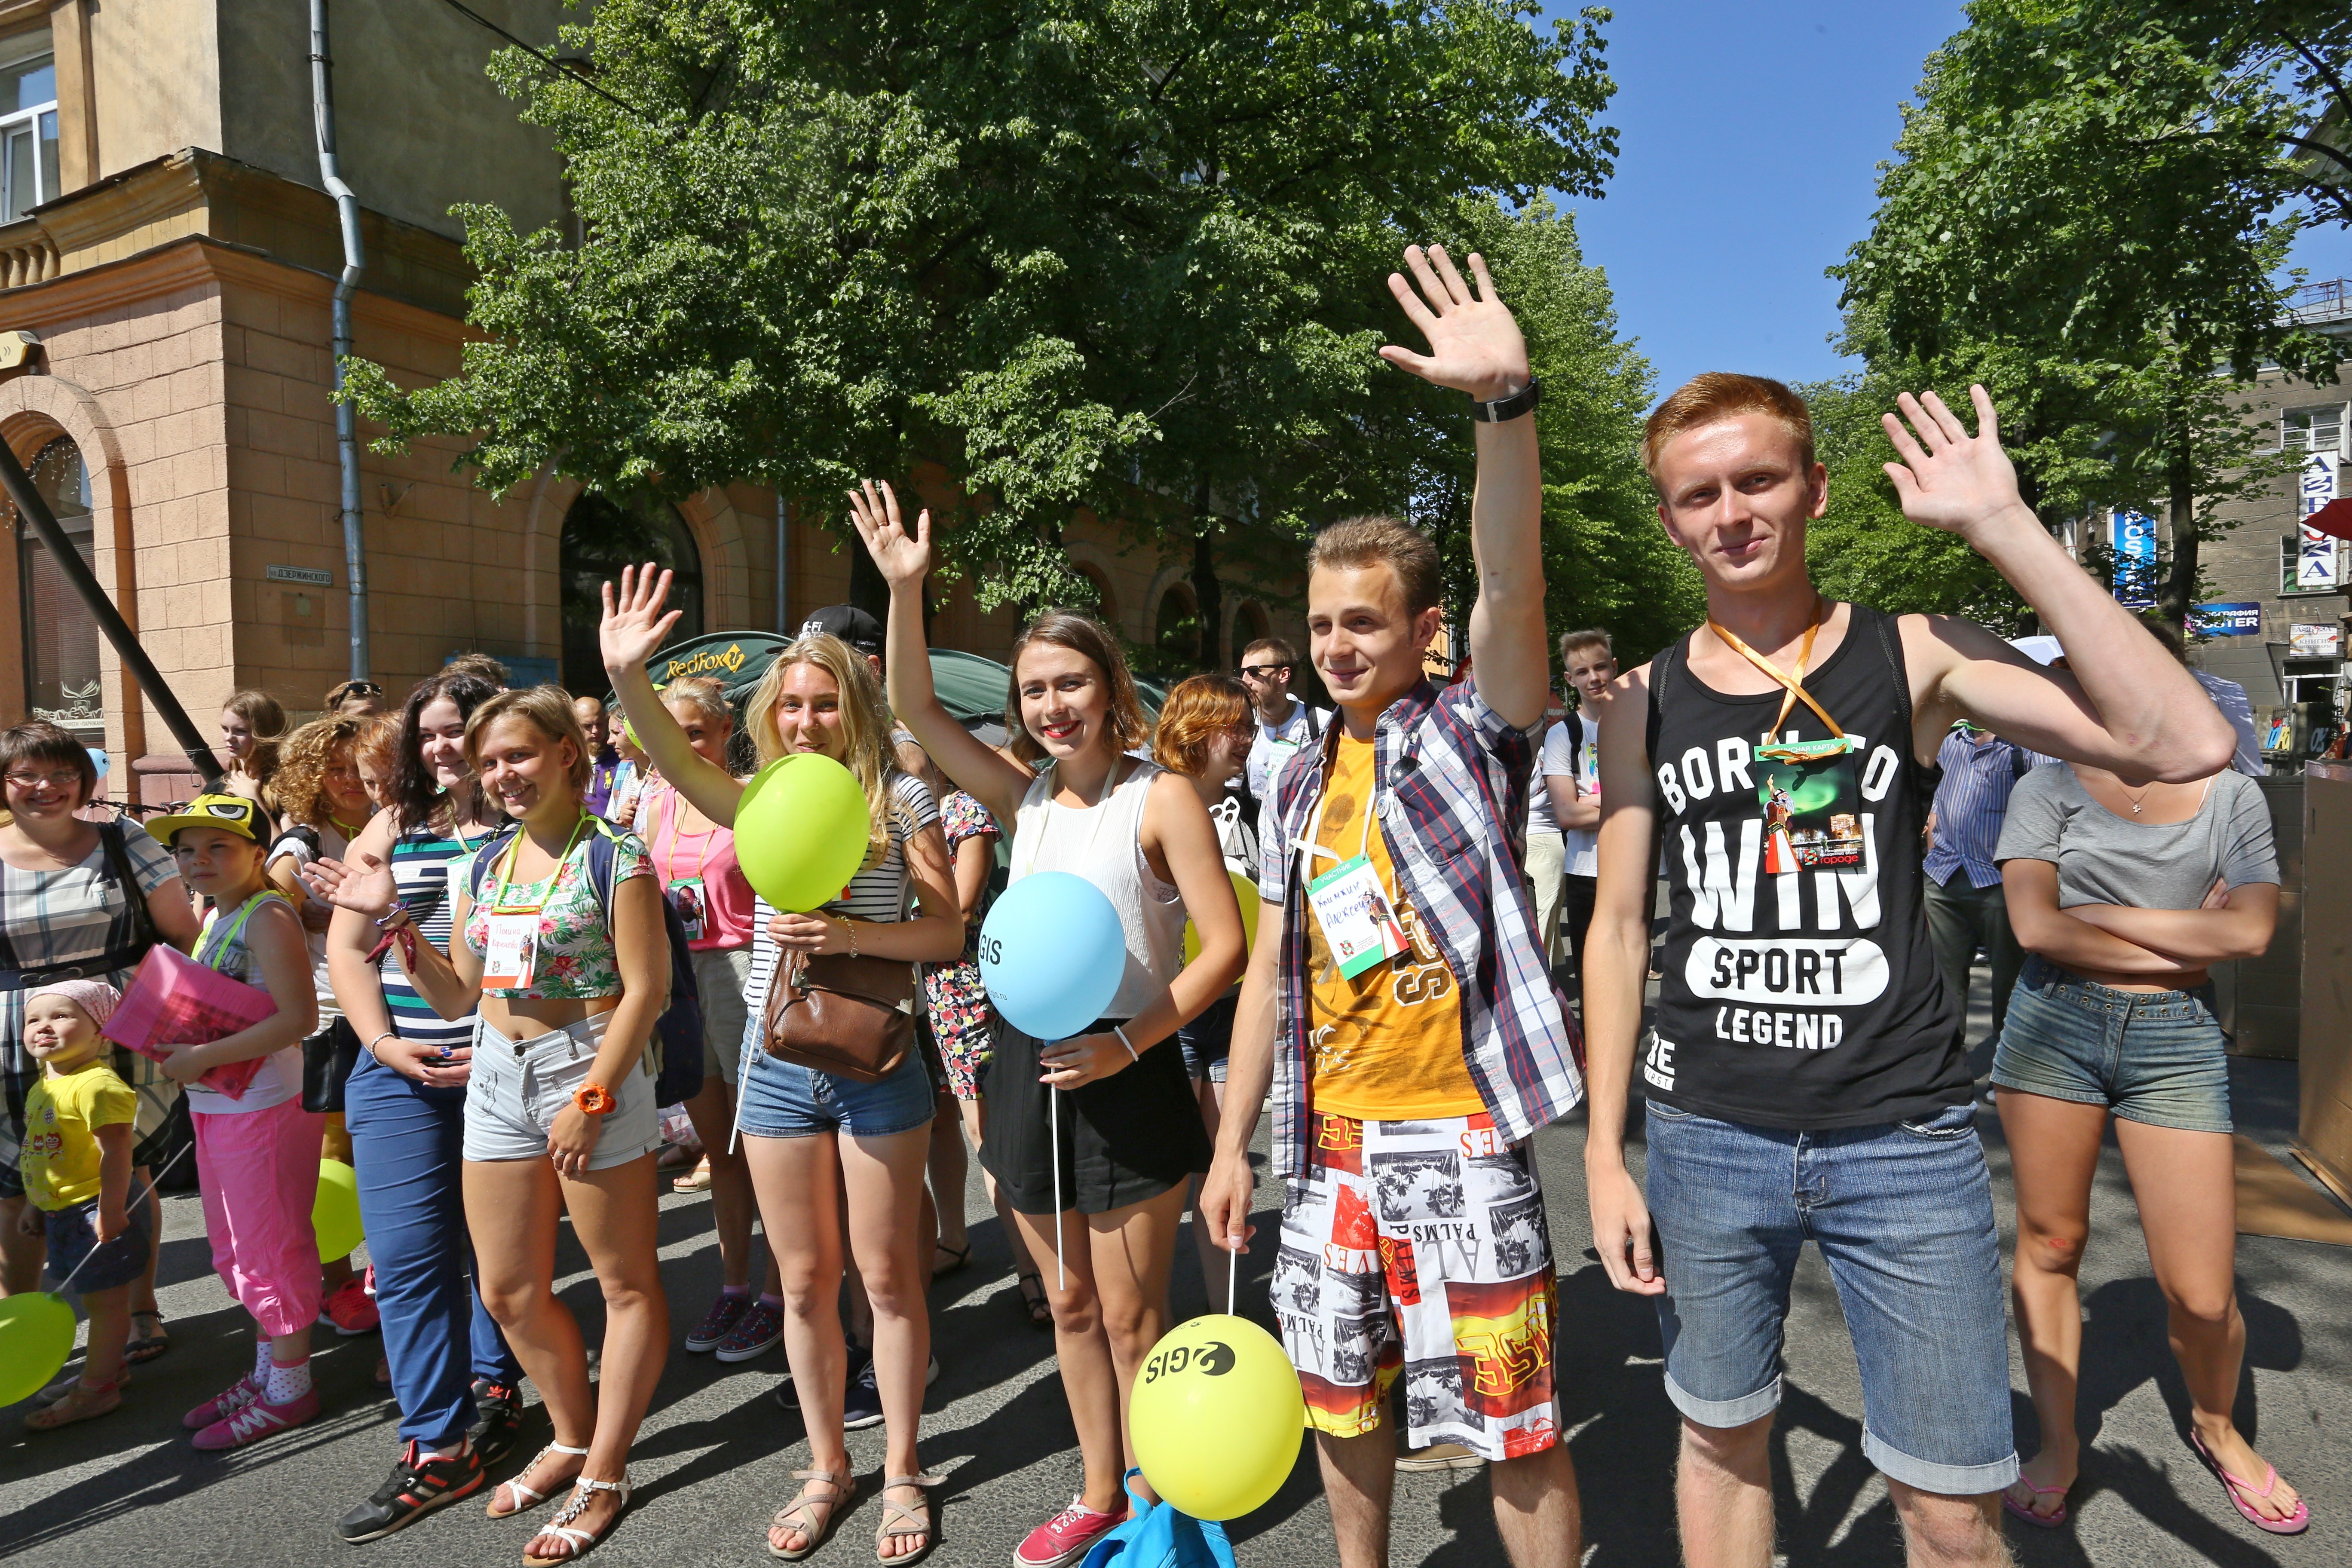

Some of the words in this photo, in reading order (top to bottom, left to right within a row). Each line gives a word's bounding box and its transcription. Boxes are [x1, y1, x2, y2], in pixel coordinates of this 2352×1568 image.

[2301, 456, 2334, 577] АЗБКА
[278, 569, 330, 582] ДЗЕРЖИНСКОГО
[2296, 625, 2332, 635] АЗБУКА
[666, 652, 725, 679] RedFox
[1320, 862, 1352, 884] УЧАСТНИК
[496, 924, 521, 935] Полина
[980, 934, 1002, 965] GIS
[1710, 947, 1847, 994] SPORT
[1715, 1006, 1843, 1050] LEGEND
[1646, 1030, 1676, 1075] BE
[1645, 1068, 1669, 1087] FIRST
[1413, 1223, 1477, 1243] PALMS
[1389, 1224, 1421, 1300] PALMS
[1280, 1312, 1323, 1338] PALMS
